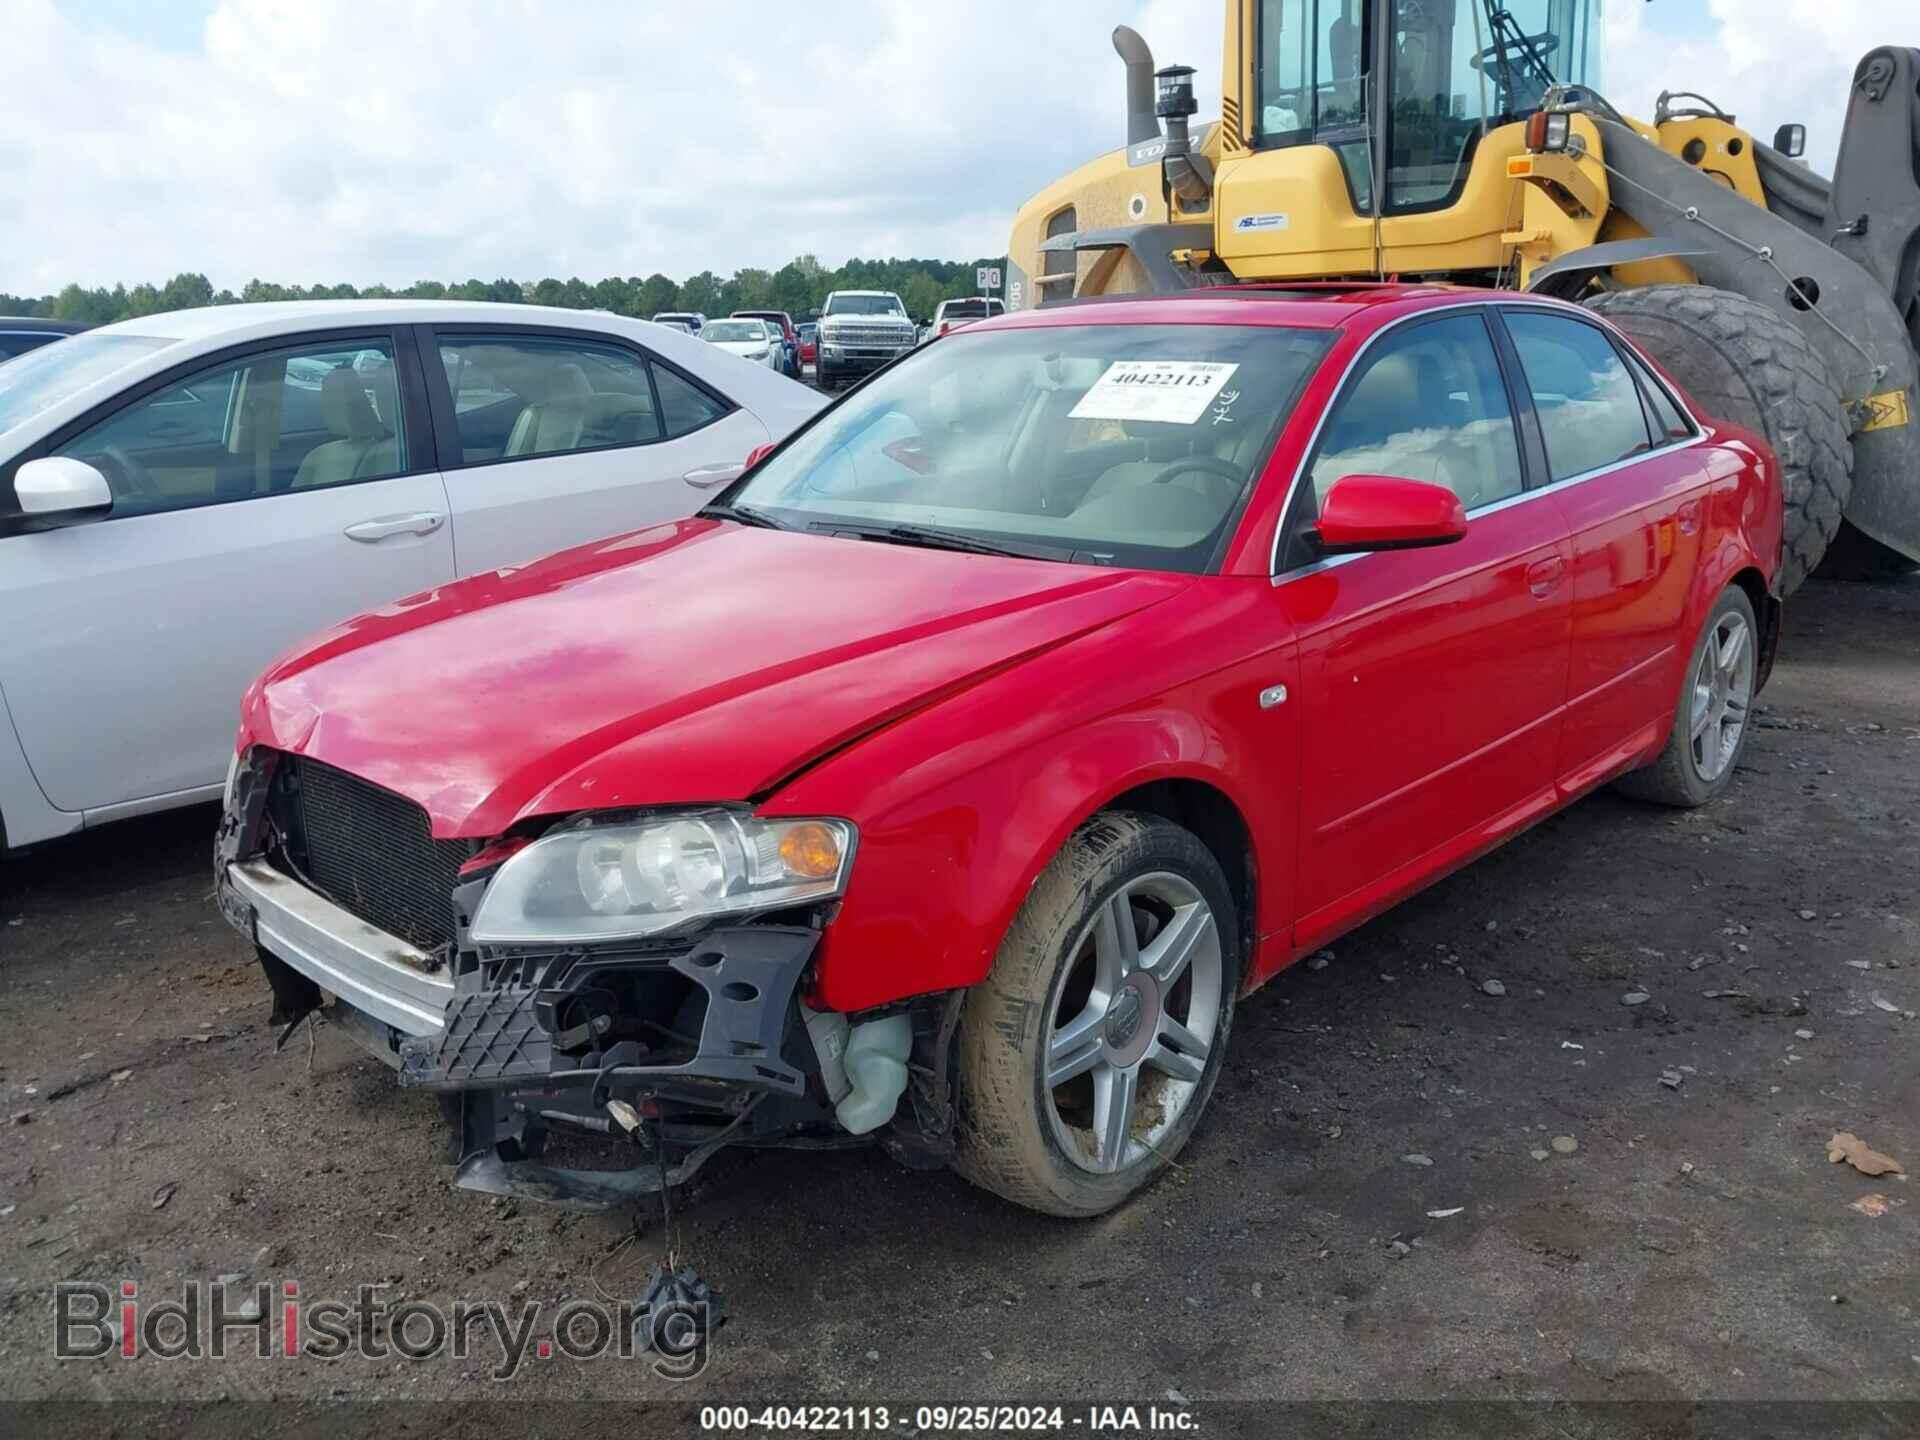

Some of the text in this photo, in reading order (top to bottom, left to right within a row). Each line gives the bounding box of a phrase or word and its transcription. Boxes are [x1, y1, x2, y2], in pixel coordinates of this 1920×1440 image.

[980, 271, 999, 286] P Q
[1112, 373, 1212, 387] 40422113
